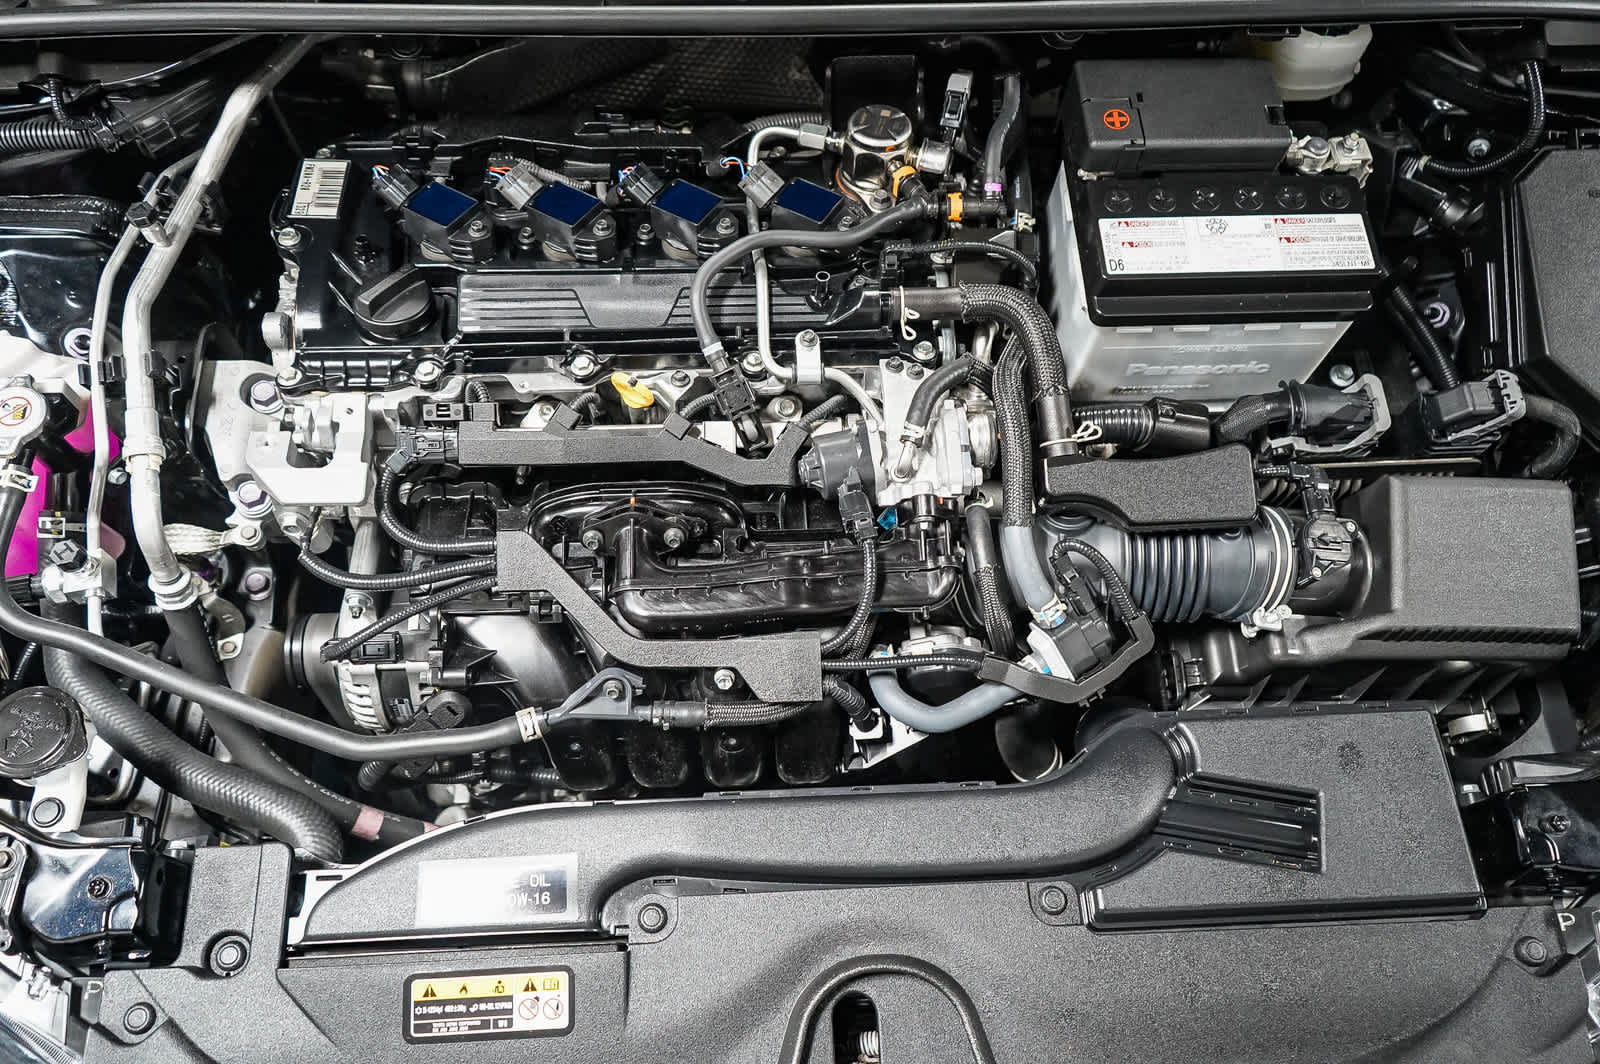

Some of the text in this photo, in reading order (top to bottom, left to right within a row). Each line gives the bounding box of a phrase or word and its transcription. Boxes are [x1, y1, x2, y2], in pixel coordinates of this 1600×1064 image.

[1108, 259, 1125, 272] D6
[529, 873, 552, 887] OIL
[1556, 912, 1576, 932] P
